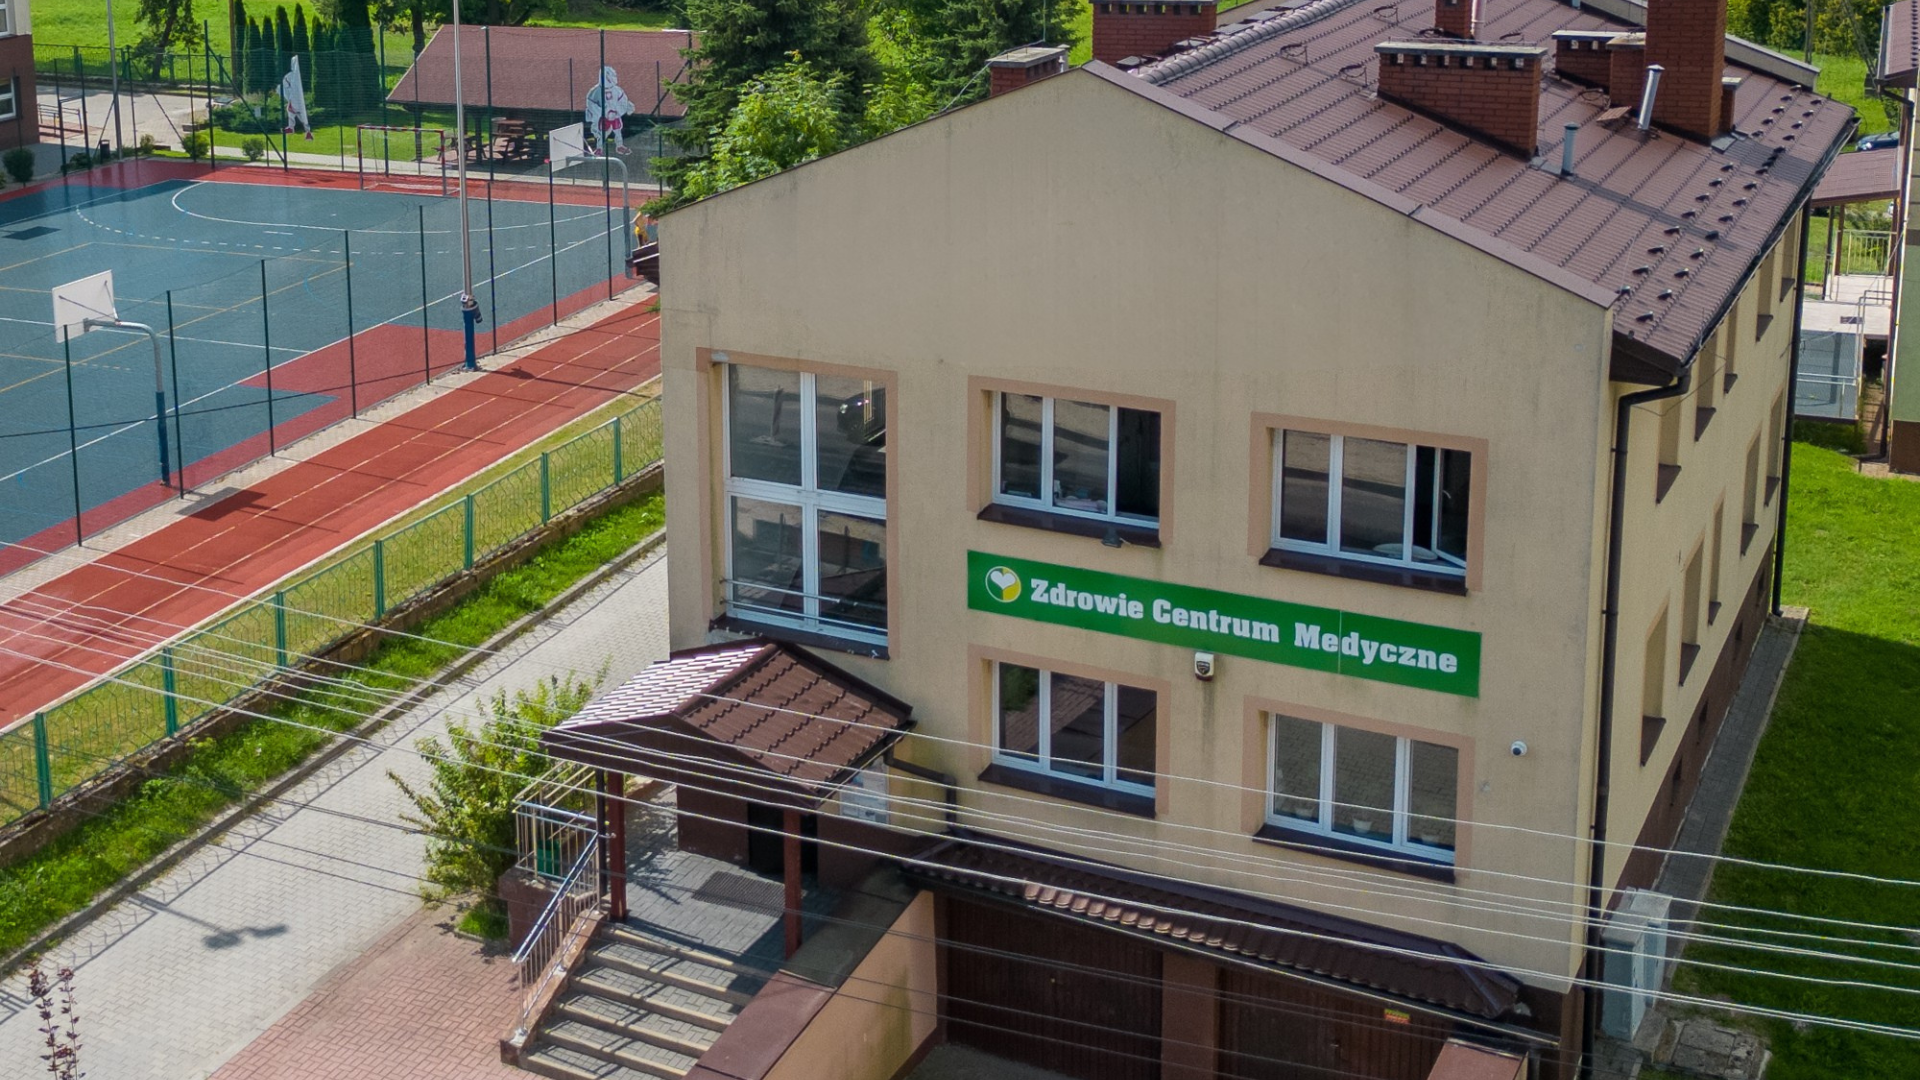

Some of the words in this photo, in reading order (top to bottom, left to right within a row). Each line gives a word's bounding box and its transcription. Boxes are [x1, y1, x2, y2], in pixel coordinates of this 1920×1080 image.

[1031, 578, 1144, 619] Zdrowie
[1152, 599, 1280, 643] Centrum
[1294, 622, 1458, 673] Medyczne
